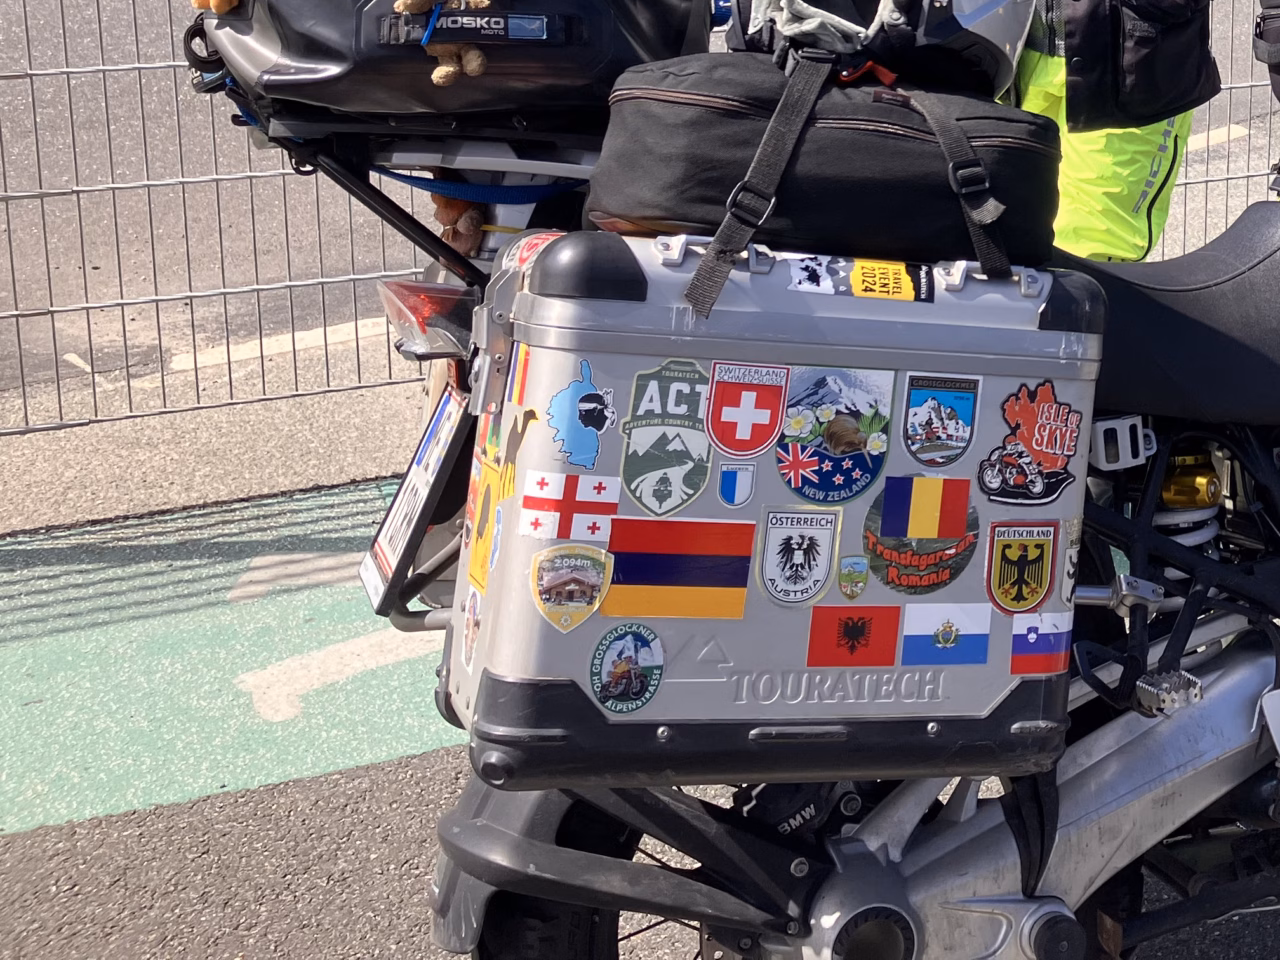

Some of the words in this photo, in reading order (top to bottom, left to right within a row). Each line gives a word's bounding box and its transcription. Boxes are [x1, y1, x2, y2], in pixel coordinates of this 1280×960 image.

[861, 265, 877, 294] 2024
[878, 266, 891, 296] EVENT
[891, 268, 903, 296] TRAVEL
[661, 370, 700, 379] TOURATECH
[717, 365, 786, 379] SWITZERLAND
[912, 379, 975, 389] GROSSGLOCKNER
[625, 418, 663, 429] ADVENTURE
[664, 419, 693, 427] COUNTRY
[1038, 402, 1069, 426] ISLE
[1069, 410, 1081, 427] OF
[1032, 421, 1078, 456] SKYE
[801, 484, 825, 501] NEW
[826, 473, 872, 502] ZEALAND
[769, 514, 834, 528] ÖSTERREICH
[996, 528, 1052, 539] DEUTSCHLAND
[768, 578, 822, 597] AUSTRIA
[886, 565, 951, 588] Romania
[592, 623, 655, 673] GROSSGLOCKNER
[604, 668, 661, 712] ALPENSTRASSE
[731, 669, 946, 704] TOURATECH
[777, 803, 816, 835] BMW
